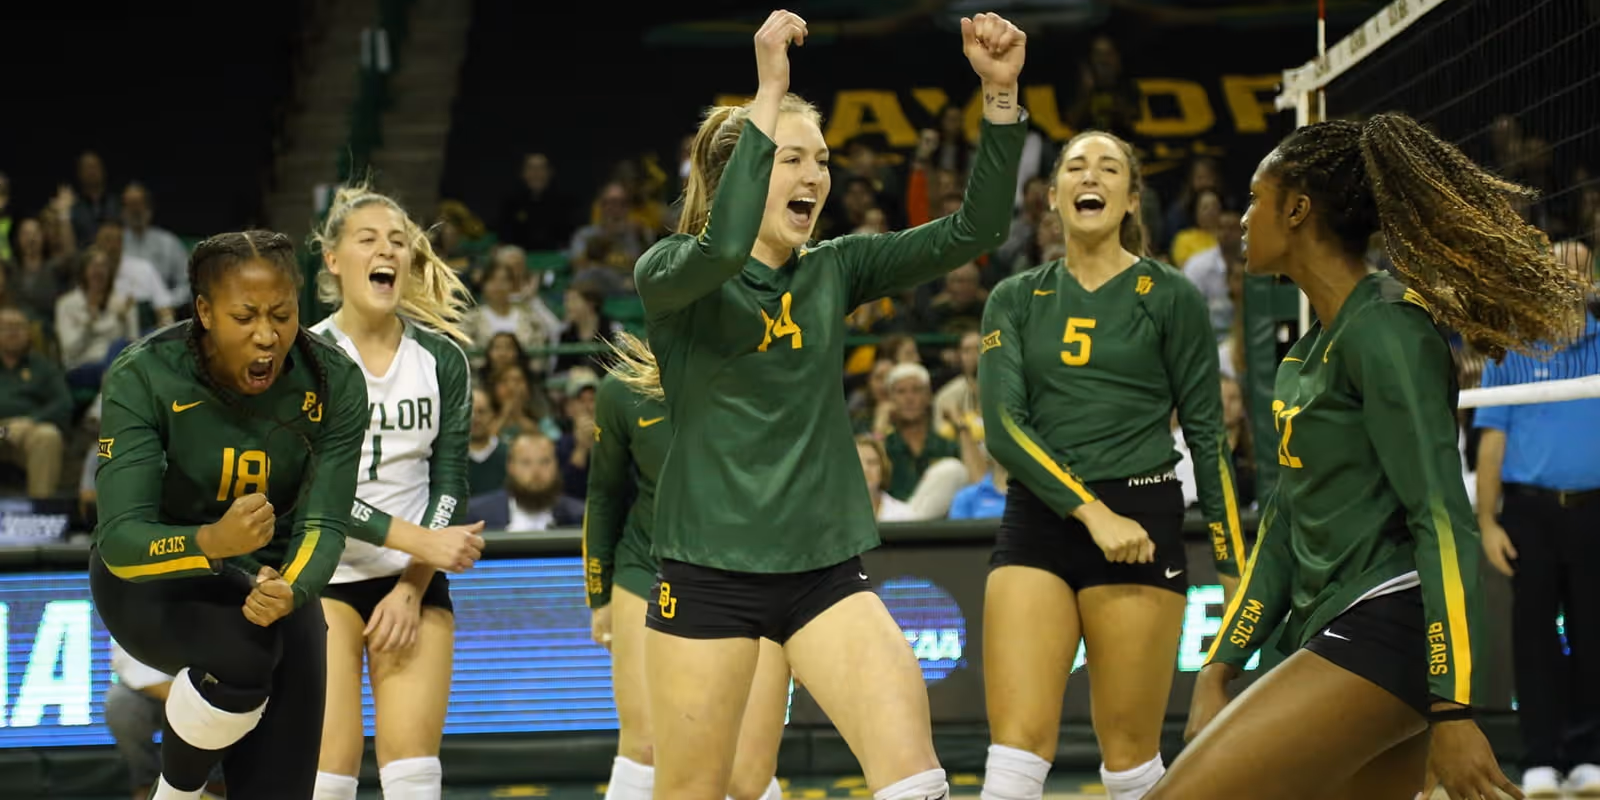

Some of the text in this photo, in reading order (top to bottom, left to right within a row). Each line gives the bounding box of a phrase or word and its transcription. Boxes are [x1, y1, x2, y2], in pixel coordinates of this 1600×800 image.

[757, 291, 802, 352] 14
[1060, 317, 1096, 366] 5
[216, 447, 270, 500] 18
[369, 435, 382, 480] 1
[1128, 474, 1162, 487] NIKE
[0, 600, 93, 727] A
[1429, 622, 1448, 676] BEARS
